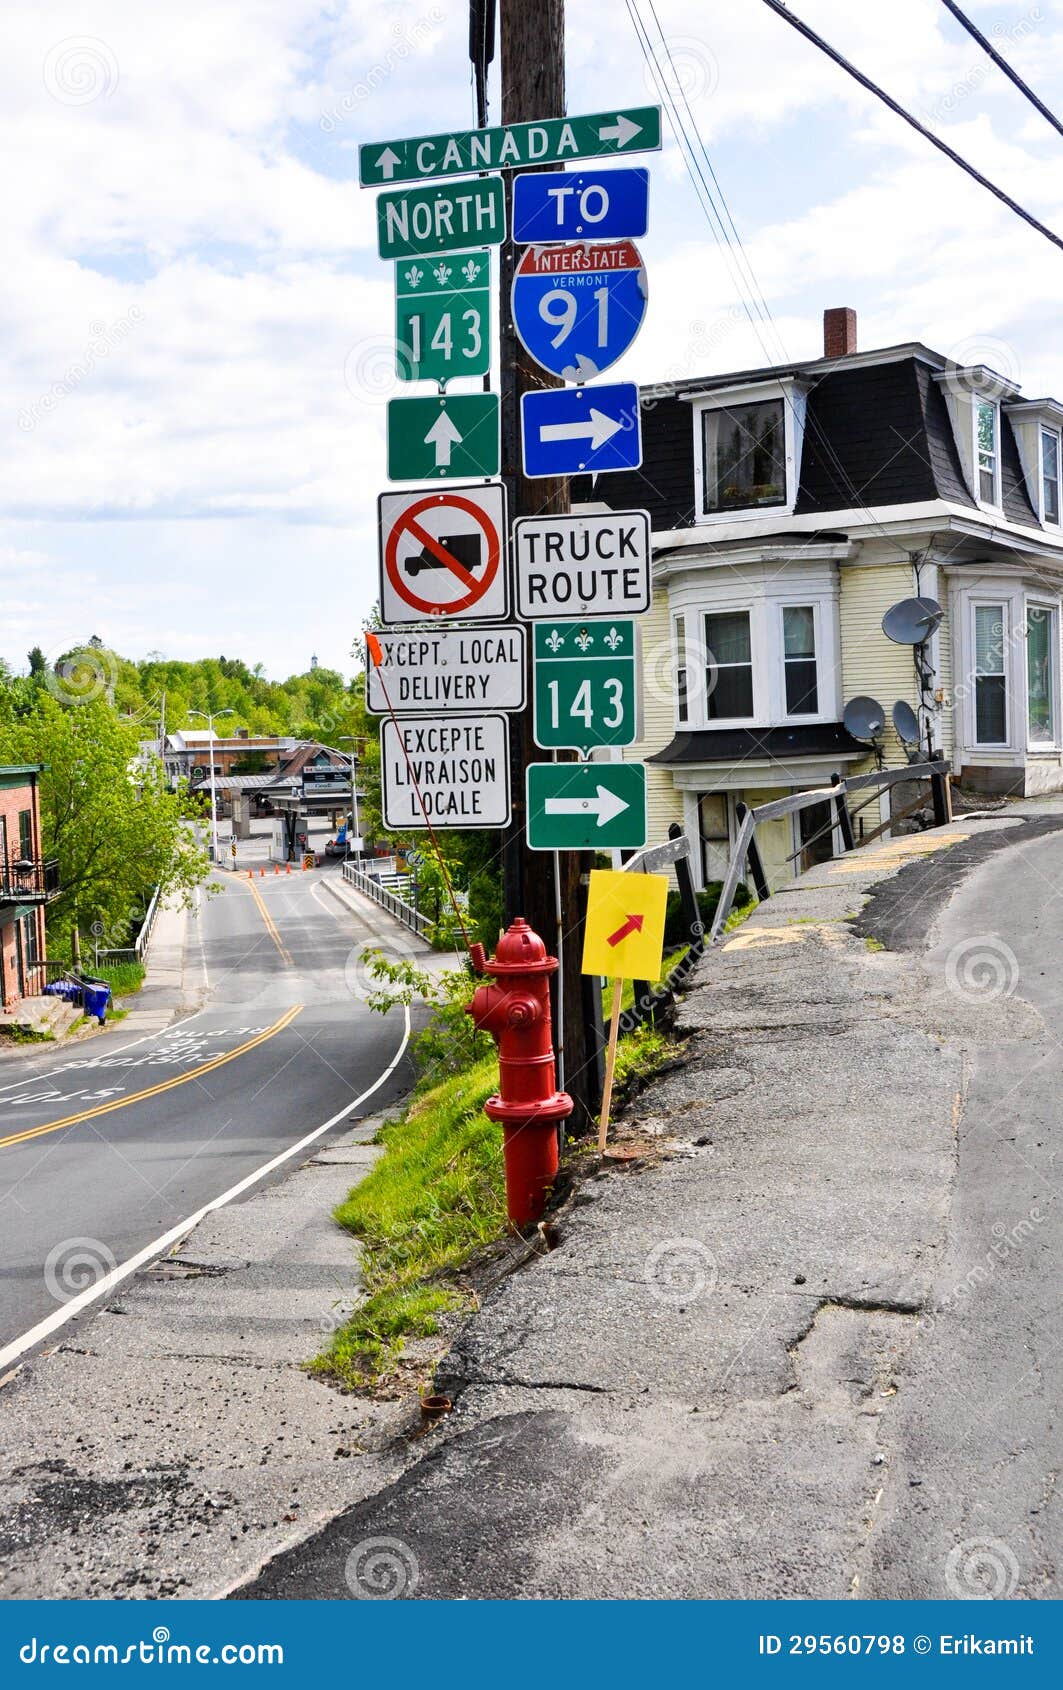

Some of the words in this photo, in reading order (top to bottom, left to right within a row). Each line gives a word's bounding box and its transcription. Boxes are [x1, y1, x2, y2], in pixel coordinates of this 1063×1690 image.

[416, 123, 579, 173] CANADA
[386, 192, 496, 244] NORTH
[547, 185, 610, 225] TO
[534, 249, 627, 271] INTERSTATE
[552, 275, 609, 287] VERMONT
[408, 309, 482, 363] 143
[538, 287, 609, 350] 91
[523, 527, 639, 564] TRUCK
[529, 568, 642, 604] ROUTE
[376, 641, 440, 667] XCEPT
[460, 638, 518, 664] LOCAL
[400, 675, 490, 700] DELIVERY
[548, 678, 624, 729] 143
[403, 727, 485, 753] EXCEPTE
[395, 759, 496, 786] LIVRAISON
[411, 791, 482, 816] LOCALE
